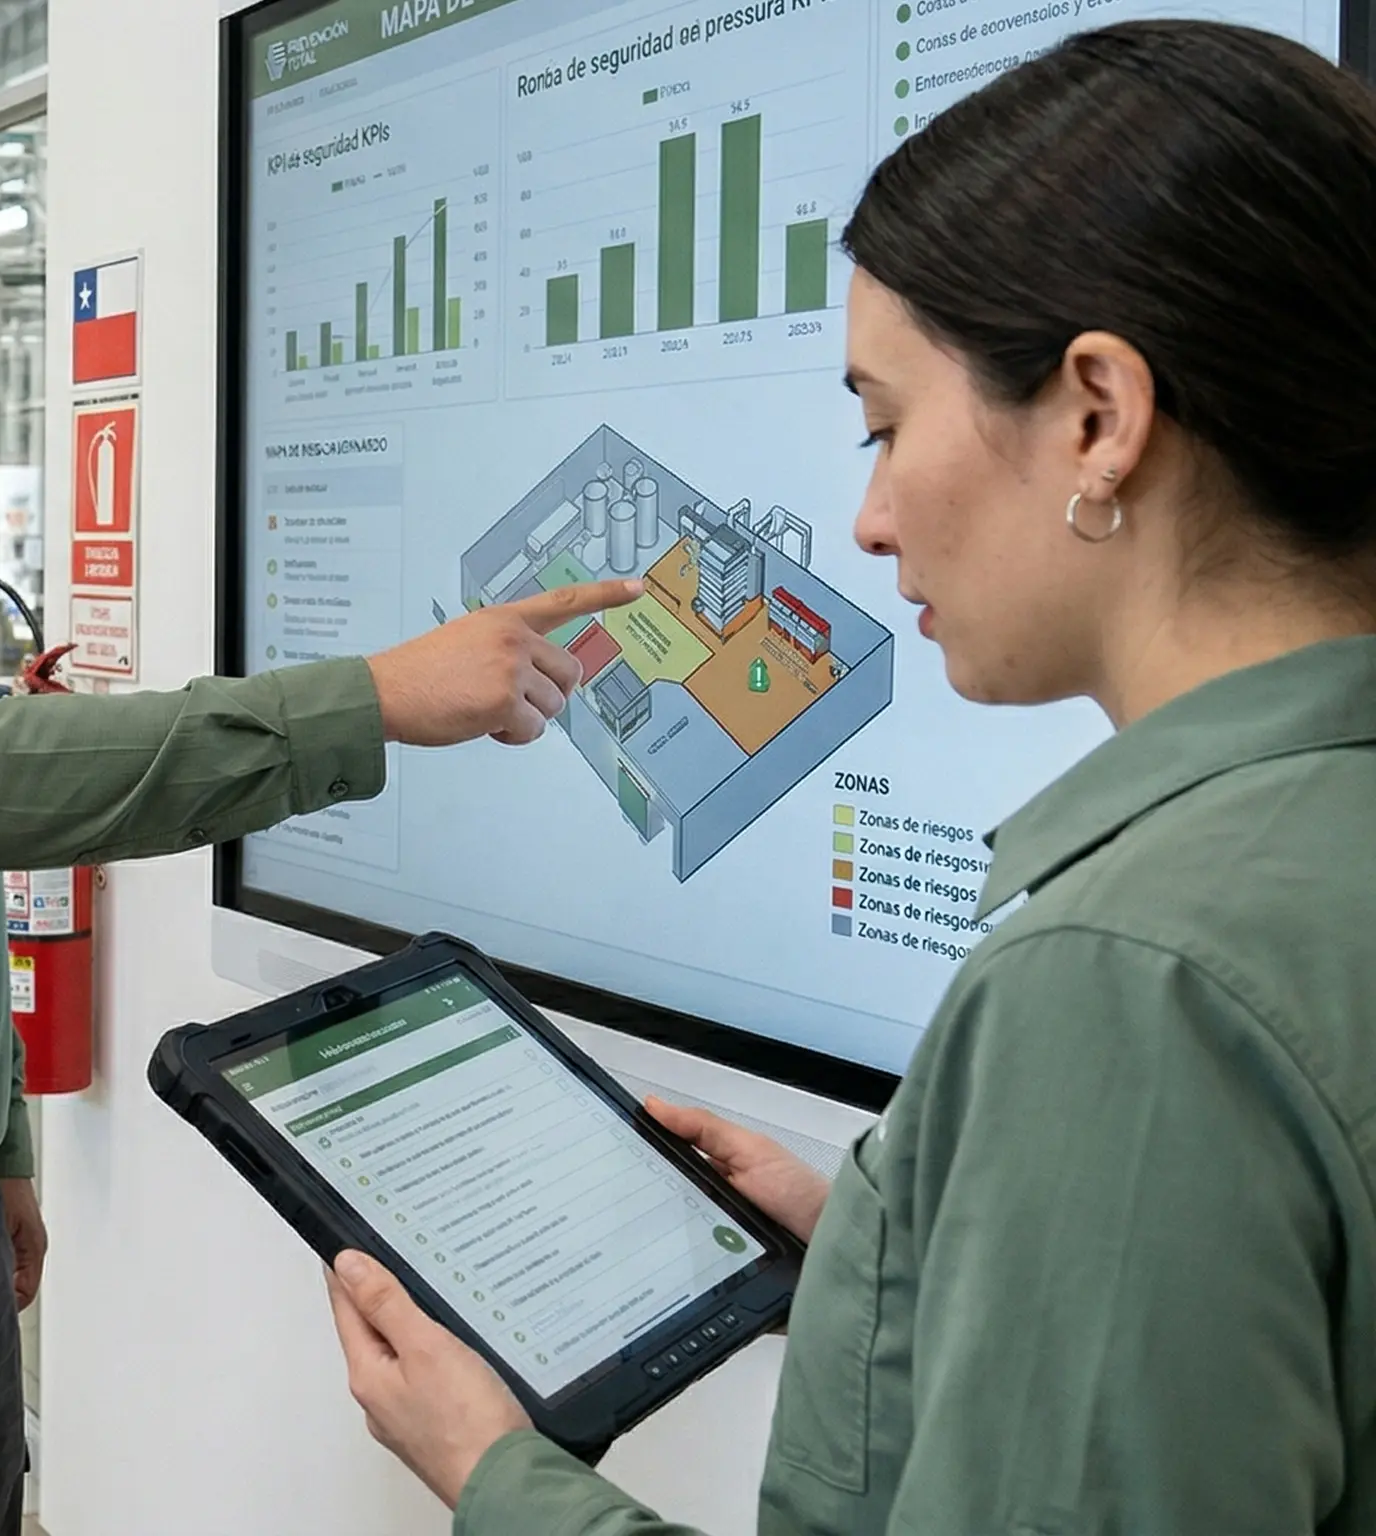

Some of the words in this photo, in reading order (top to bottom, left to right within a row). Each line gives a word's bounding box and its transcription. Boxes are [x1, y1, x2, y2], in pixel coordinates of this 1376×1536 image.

[382, 0, 441, 39] MAPA
[567, 56, 586, 81] de
[590, 25, 673, 74] seguridad
[706, 0, 785, 43] pressura
[960, 25, 977, 42] de
[361, 121, 390, 148] KPIs
[834, 772, 890, 795] ZONAS
[859, 810, 899, 830] Zonas
[903, 817, 919, 832] de
[922, 821, 974, 843] riesgos
[859, 838, 901, 858] Zonas
[905, 844, 922, 862] de
[859, 867, 900, 888] Zonas
[904, 873, 921, 892] de
[925, 879, 977, 903] riesgos
[859, 894, 900, 916] Zonas
[904, 902, 921, 920] de
[858, 922, 898, 944] Zonas
[902, 931, 919, 949] de
